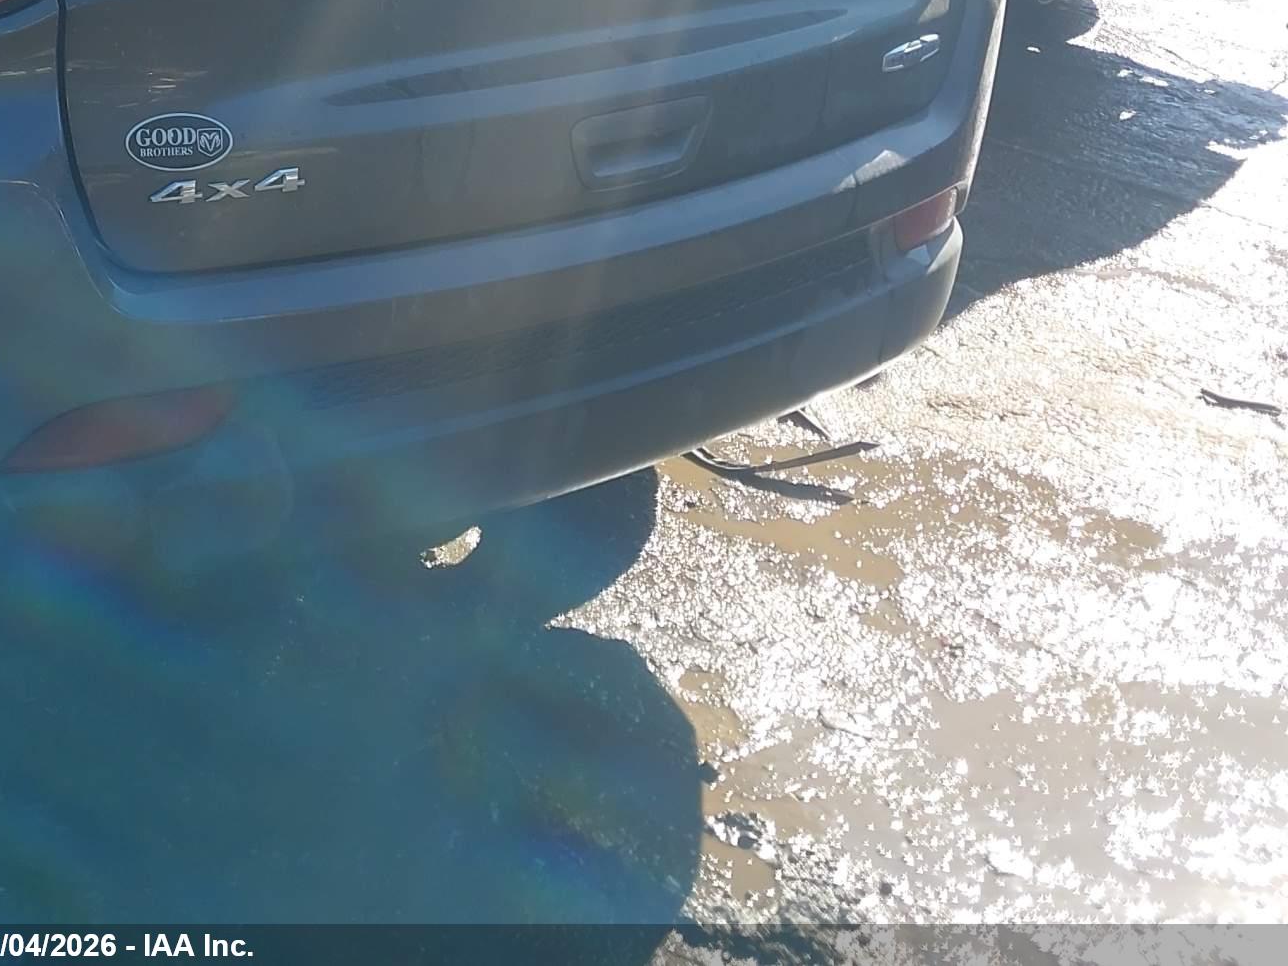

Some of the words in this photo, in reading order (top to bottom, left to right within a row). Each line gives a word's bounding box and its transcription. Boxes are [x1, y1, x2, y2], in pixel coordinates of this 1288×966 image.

[136, 127, 197, 147] GOOD
[140, 146, 194, 157] BROTHERS
[149, 167, 305, 204] 4x4
